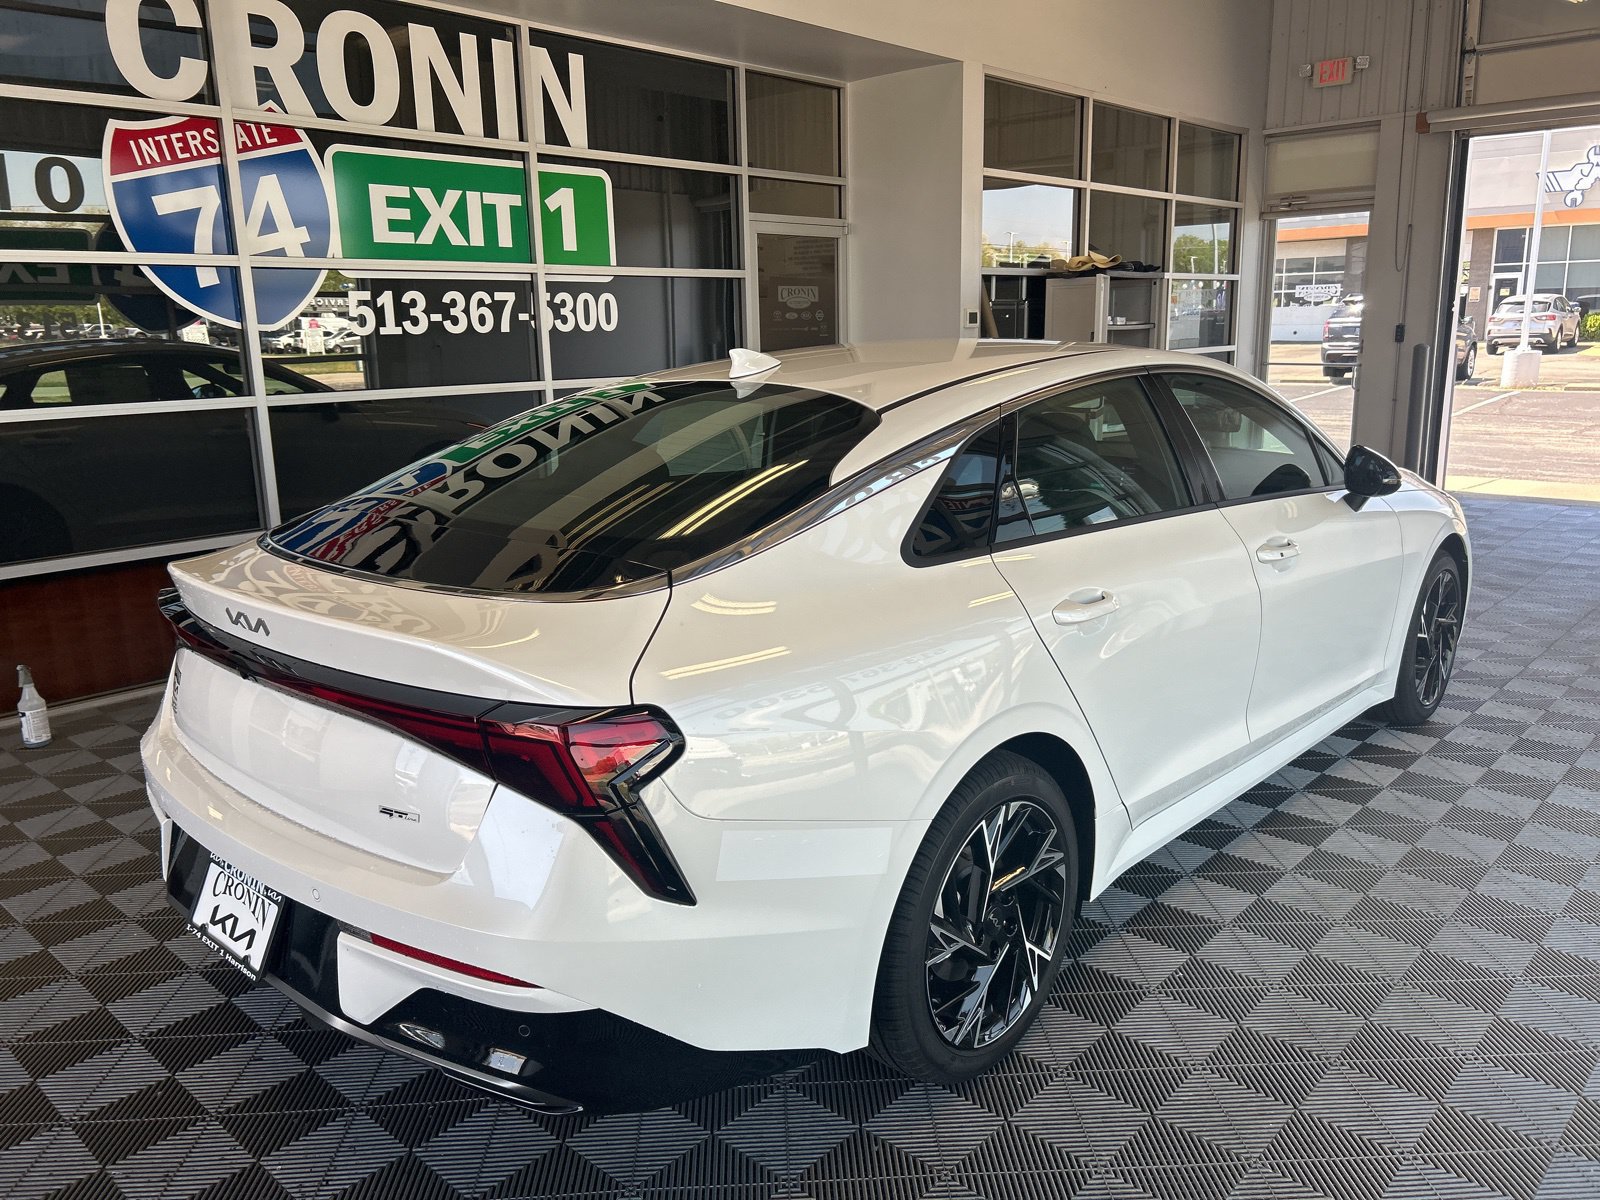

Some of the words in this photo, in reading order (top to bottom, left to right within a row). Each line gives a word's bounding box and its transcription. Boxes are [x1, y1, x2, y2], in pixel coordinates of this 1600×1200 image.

[105, 0, 589, 149] CRONIN
[1318, 58, 1349, 84] EXIT
[129, 122, 278, 166] INTERSATE
[151, 174, 311, 288] 74
[368, 183, 523, 248] EXIT
[544, 187, 578, 252] 1
[780, 287, 817, 300] CRONIN
[212, 870, 272, 931] CRONIN
[201, 934, 220, 952] EXIT
[219, 949, 225, 957] 1
[225, 952, 257, 981] Harrison
